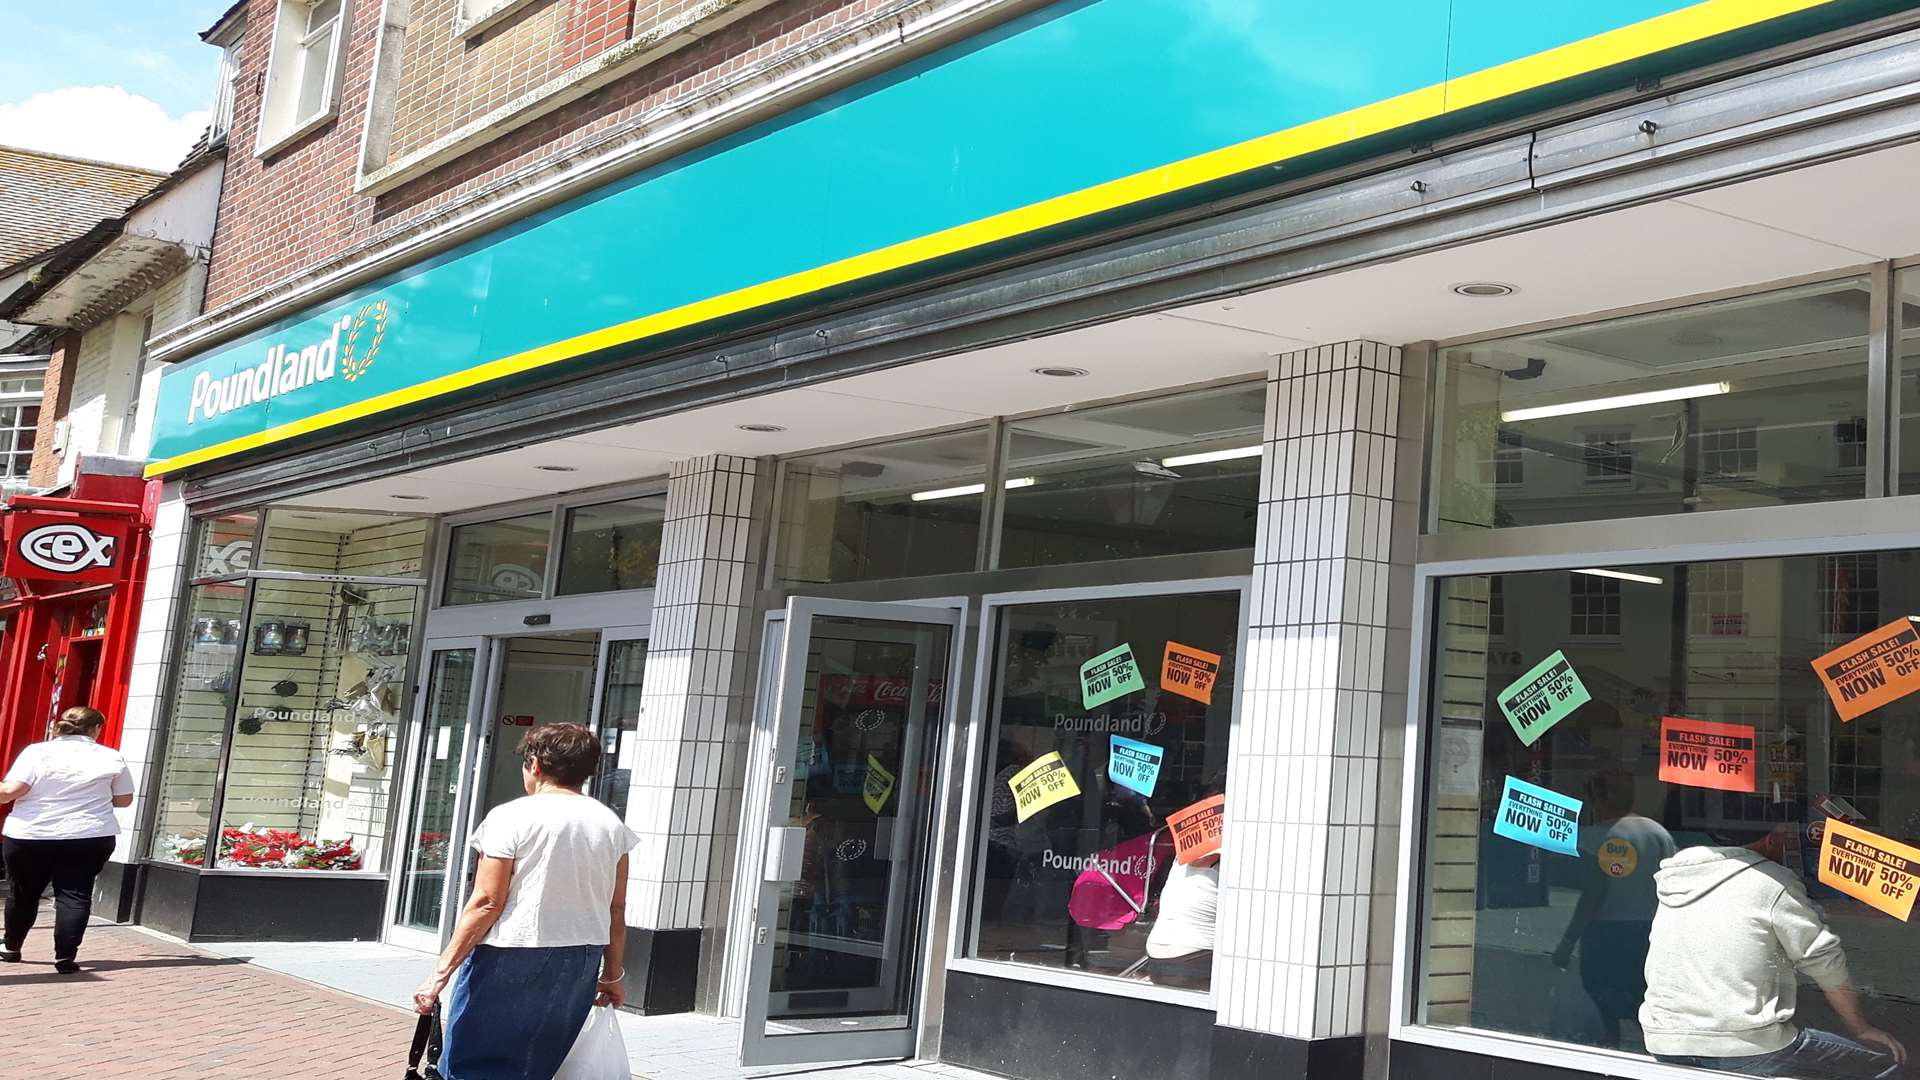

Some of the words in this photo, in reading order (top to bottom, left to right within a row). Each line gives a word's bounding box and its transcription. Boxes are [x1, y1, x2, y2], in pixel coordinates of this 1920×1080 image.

[187, 322, 341, 424] Poundland
[1175, 654, 1192, 665] FLASH
[1193, 659, 1209, 669] SALE!
[1840, 653, 1870, 671] FLASH
[1870, 637, 1900, 656] SALE!
[1883, 645, 1920, 667] 50%
[1090, 663, 1107, 675] FLASH
[1107, 656, 1122, 668] SALE!
[1112, 663, 1133, 676] 50%
[1835, 660, 1879, 686] EVERYTHING
[1896, 658, 1920, 676] OFF
[1117, 672, 1132, 684] OFF
[1167, 667, 1191, 685] NOW
[1193, 669, 1211, 683] 50%
[1547, 673, 1573, 695] 50%
[1839, 667, 1887, 702] NOW
[1087, 676, 1112, 697] NOW
[1194, 681, 1207, 691] OFF
[1516, 684, 1538, 703] FLASH
[1537, 668, 1558, 686] SALE!
[1556, 684, 1574, 702] OFF
[1513, 690, 1545, 716] EVERYTHING
[254, 707, 356, 722] Poundland
[1516, 696, 1551, 729] NOW
[1054, 712, 1142, 732] Poundland
[1680, 732, 1706, 743] FLASH
[1708, 736, 1735, 747] SALE!
[1119, 747, 1135, 757] FLASH
[1135, 751, 1151, 761] SALE!
[1667, 751, 1708, 771] NOW
[1713, 749, 1748, 764] 50%
[1113, 760, 1135, 778] NOW
[1137, 762, 1155, 775] 50%
[1718, 763, 1743, 775] OFF
[1040, 770, 1066, 786] 50%
[1047, 780, 1066, 792] OFF
[1137, 774, 1150, 783] OFF
[1020, 786, 1041, 808] NOW
[1519, 793, 1542, 809] FLASH
[1543, 802, 1566, 816] SALE!
[1508, 801, 1543, 818] EVERYTHING
[1505, 808, 1542, 833] NOW
[1546, 815, 1573, 834] 50%
[1179, 829, 1202, 852] NOW
[1208, 826, 1223, 838] OFF
[1549, 828, 1568, 842] OFF
[1607, 842, 1627, 856] Buy
[1845, 839, 1876, 858] FLASH
[1877, 852, 1906, 870] SALE!
[1042, 849, 1131, 875] Poundland
[1831, 848, 1877, 870] EVERYTHING
[1829, 855, 1874, 887] NOW
[1880, 867, 1913, 891] 50%
[1880, 883, 1905, 900] OFF
